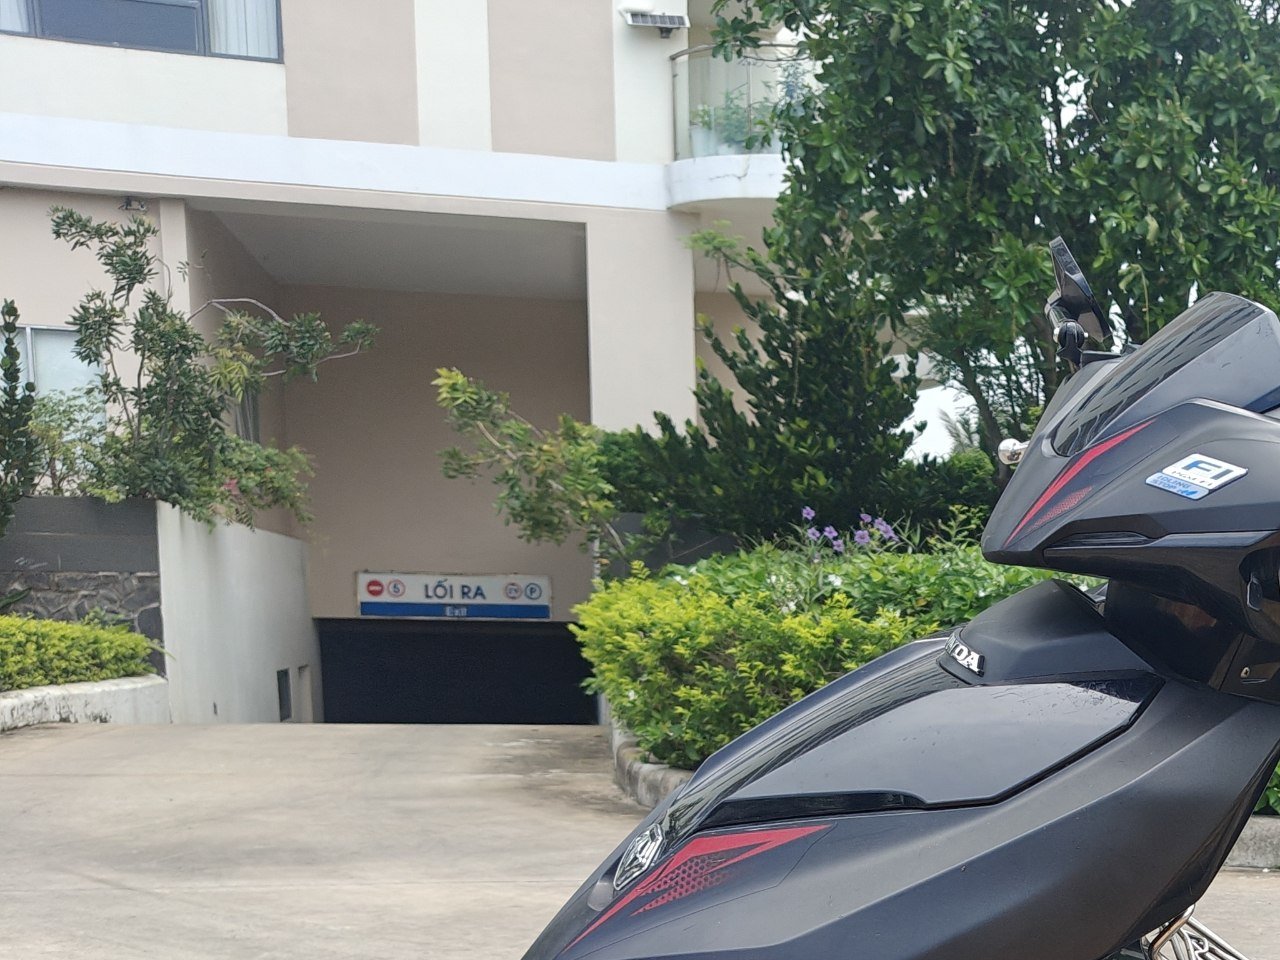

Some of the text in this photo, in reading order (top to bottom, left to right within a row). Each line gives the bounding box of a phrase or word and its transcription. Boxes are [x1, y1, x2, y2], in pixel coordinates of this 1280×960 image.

[1181, 459, 1234, 481] FI
[424, 578, 454, 600] LỐI
[461, 584, 487, 600] RA
